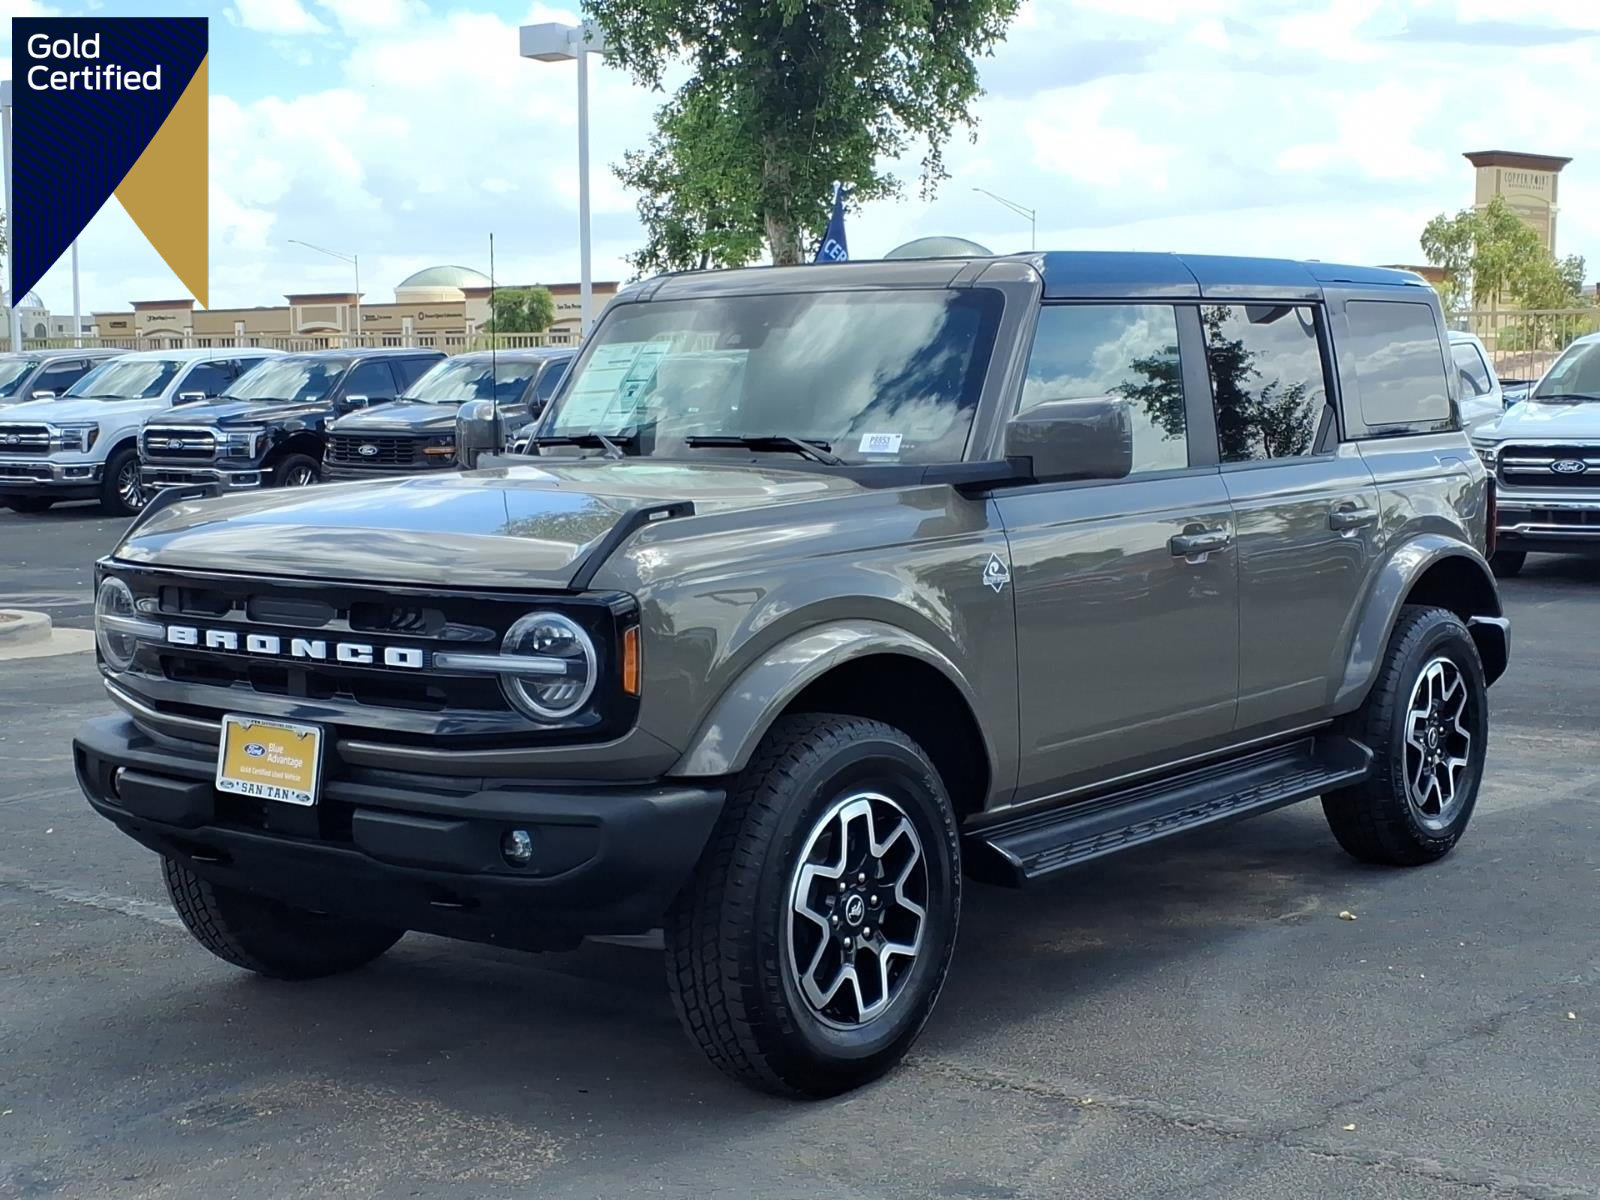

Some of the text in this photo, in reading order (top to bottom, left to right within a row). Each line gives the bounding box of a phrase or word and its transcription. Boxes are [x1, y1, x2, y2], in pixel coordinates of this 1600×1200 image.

[1556, 461, 1580, 472] Ford
[167, 625, 423, 668] BRONCO
[246, 744, 264, 756] Ford
[268, 742, 284, 754] Blue
[267, 753, 303, 769] Advantage
[241, 782, 263, 795] SAN
[267, 786, 290, 800] TAN
